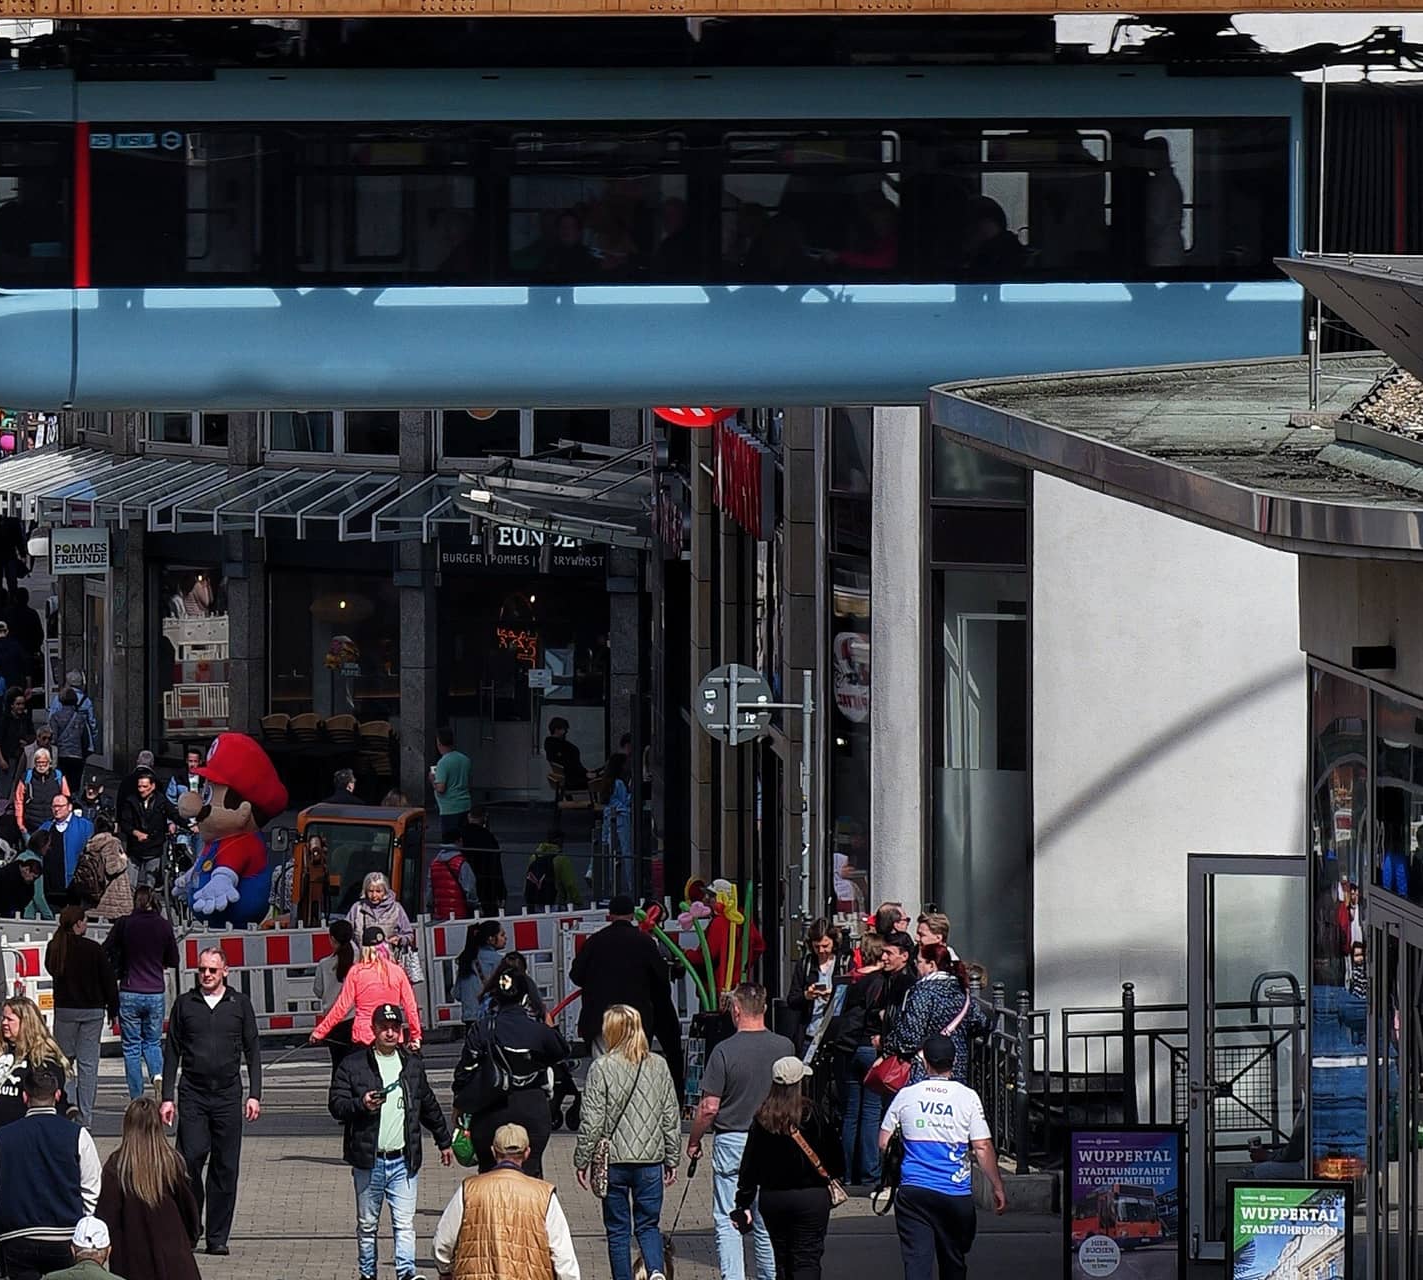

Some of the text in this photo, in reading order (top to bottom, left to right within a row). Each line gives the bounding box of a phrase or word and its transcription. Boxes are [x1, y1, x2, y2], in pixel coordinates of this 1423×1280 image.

[54, 543, 107, 554] POMMES
[54, 553, 107, 565] FREUNDE
[442, 553, 605, 568] BURGER POMMES CRRYWURST
[925, 1086, 949, 1095] HUGO
[918, 1100, 954, 1117] VISA
[1078, 1149, 1172, 1162] WUPPERTAL
[1078, 1167, 1171, 1176] STADTRUNDFAHRT
[1078, 1176, 1165, 1186] IM OLDTIMERBUS
[1240, 1206, 1339, 1222] WUPPERTAL
[1240, 1223, 1339, 1236] STADTFÜHRUNGEN
